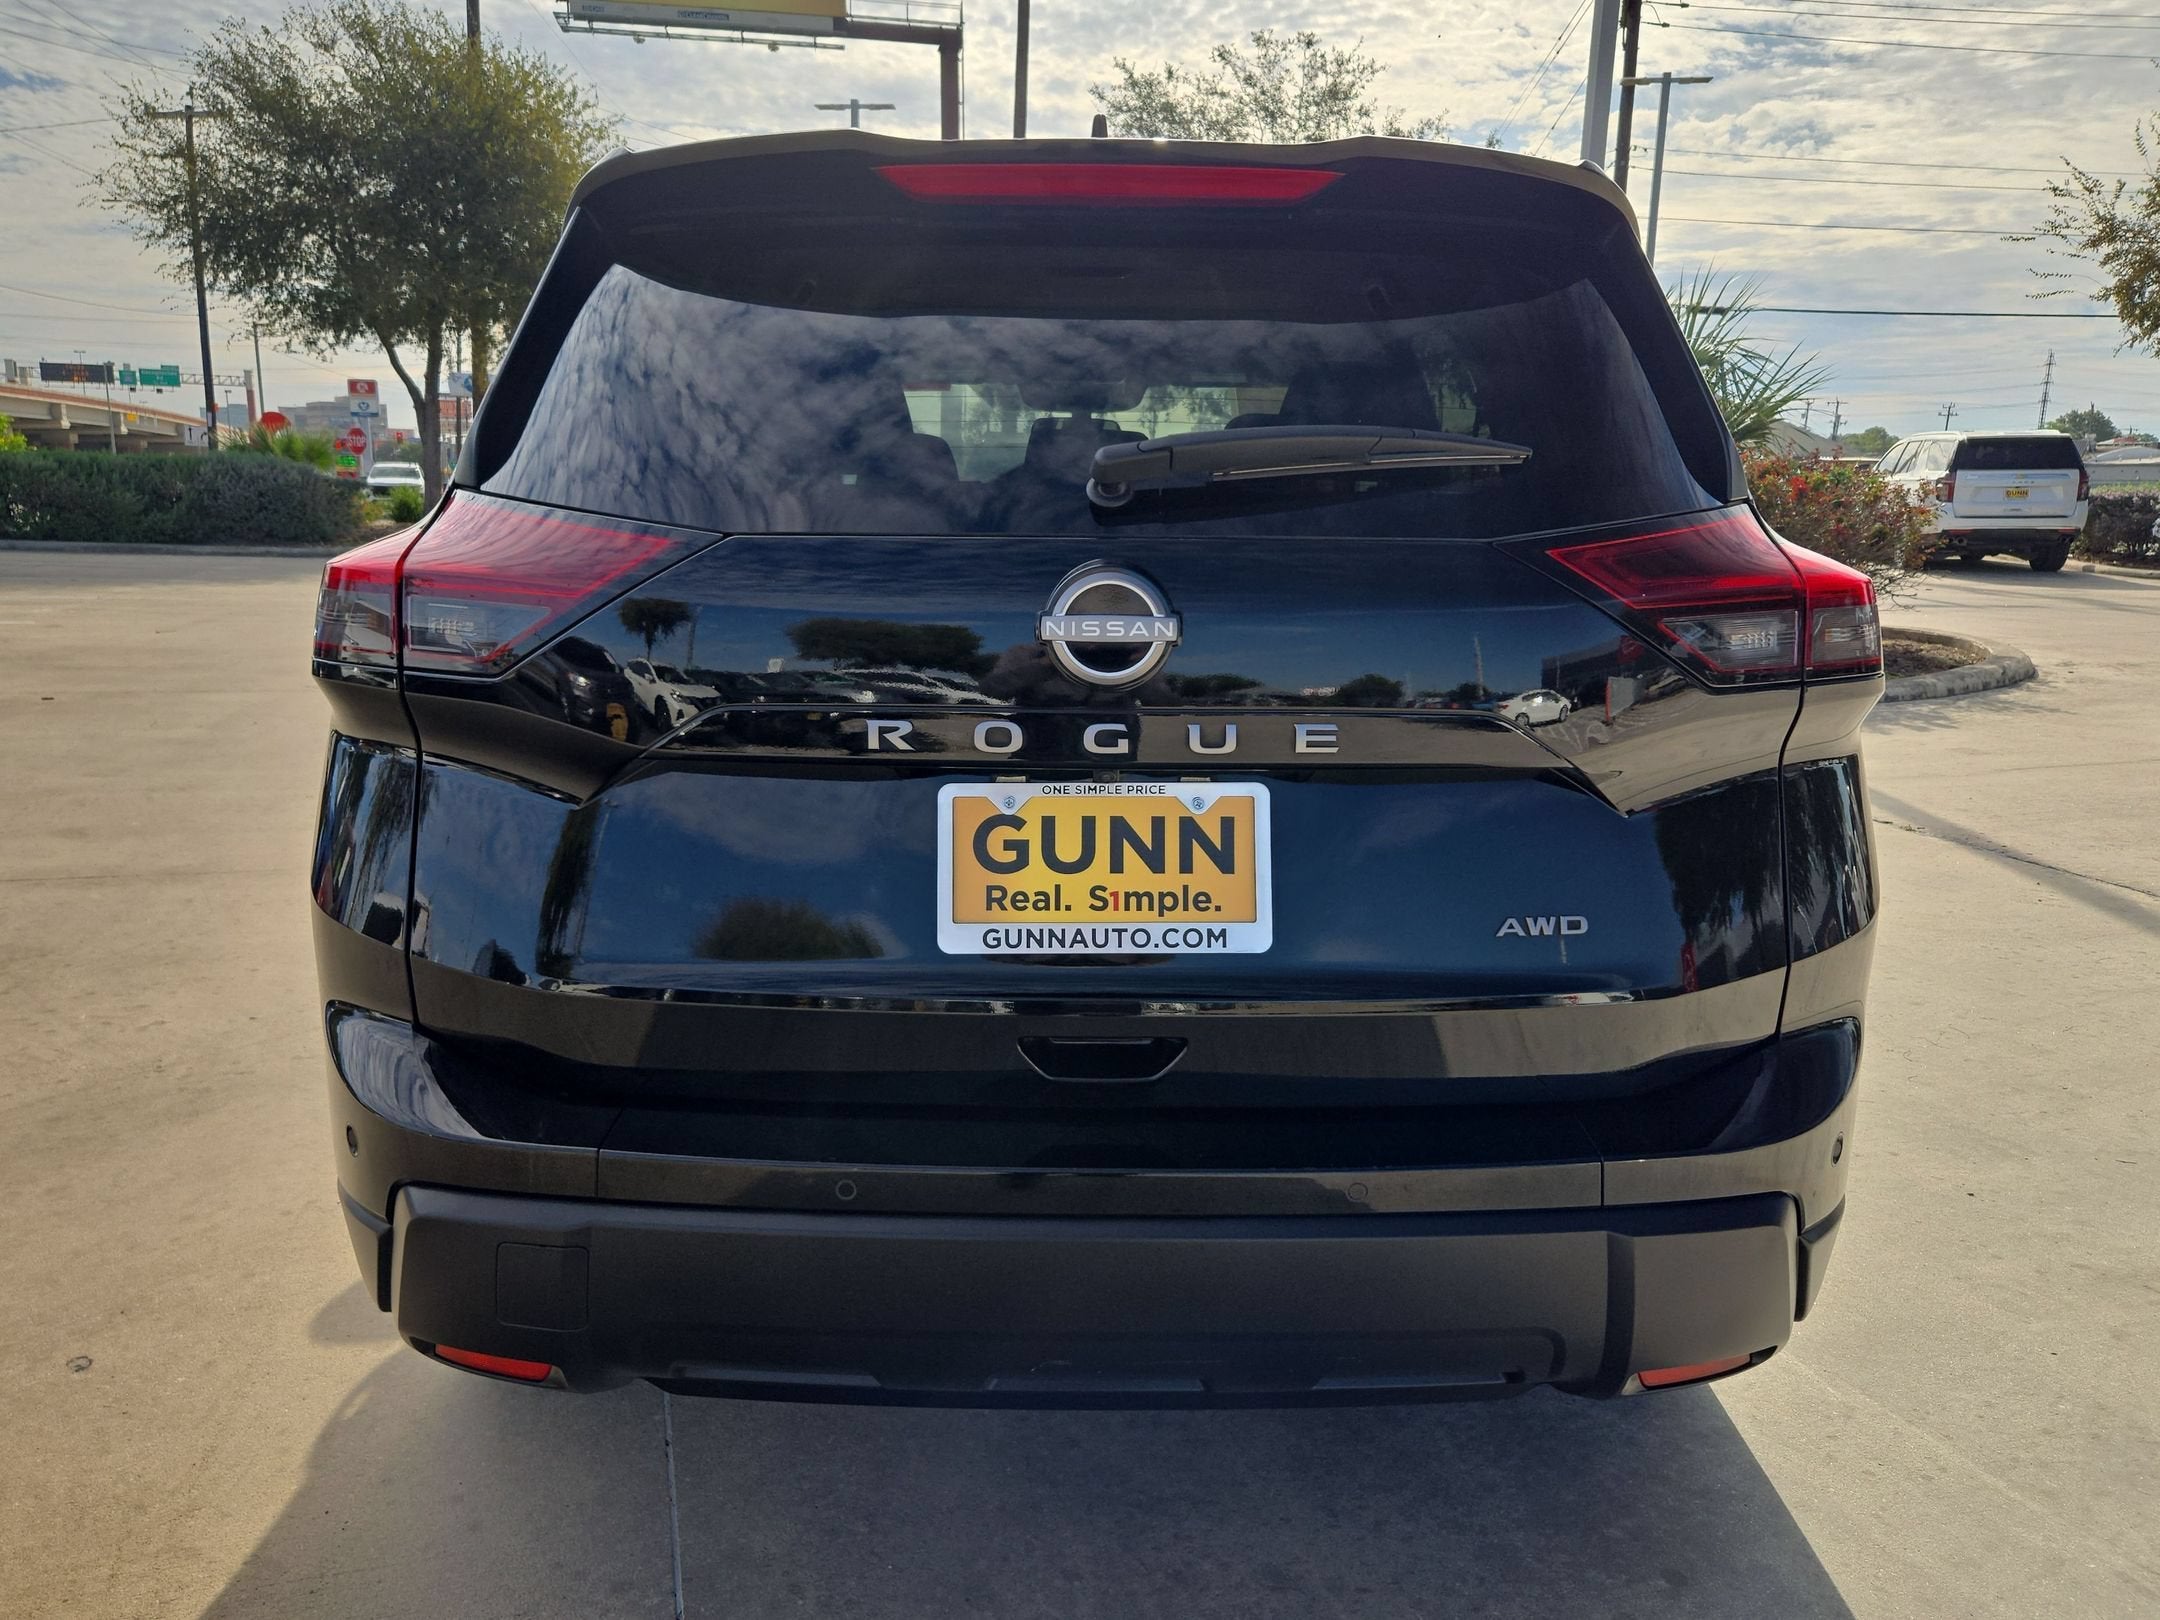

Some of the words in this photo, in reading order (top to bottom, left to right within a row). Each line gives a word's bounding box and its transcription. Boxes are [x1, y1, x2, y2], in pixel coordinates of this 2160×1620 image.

[350, 436, 366, 447] STOP
[1044, 620, 1175, 637] NISSAN
[866, 719, 1340, 754] ROGUE
[1042, 785, 1070, 794] ONE
[1075, 785, 1121, 794] SIMPLE
[1127, 785, 1166, 794] PRICE
[972, 814, 1235, 875] GUNN
[986, 884, 1072, 912] Real.
[1496, 915, 1589, 937] AWD
[982, 927, 1228, 949] GUNNAUTO.COM
